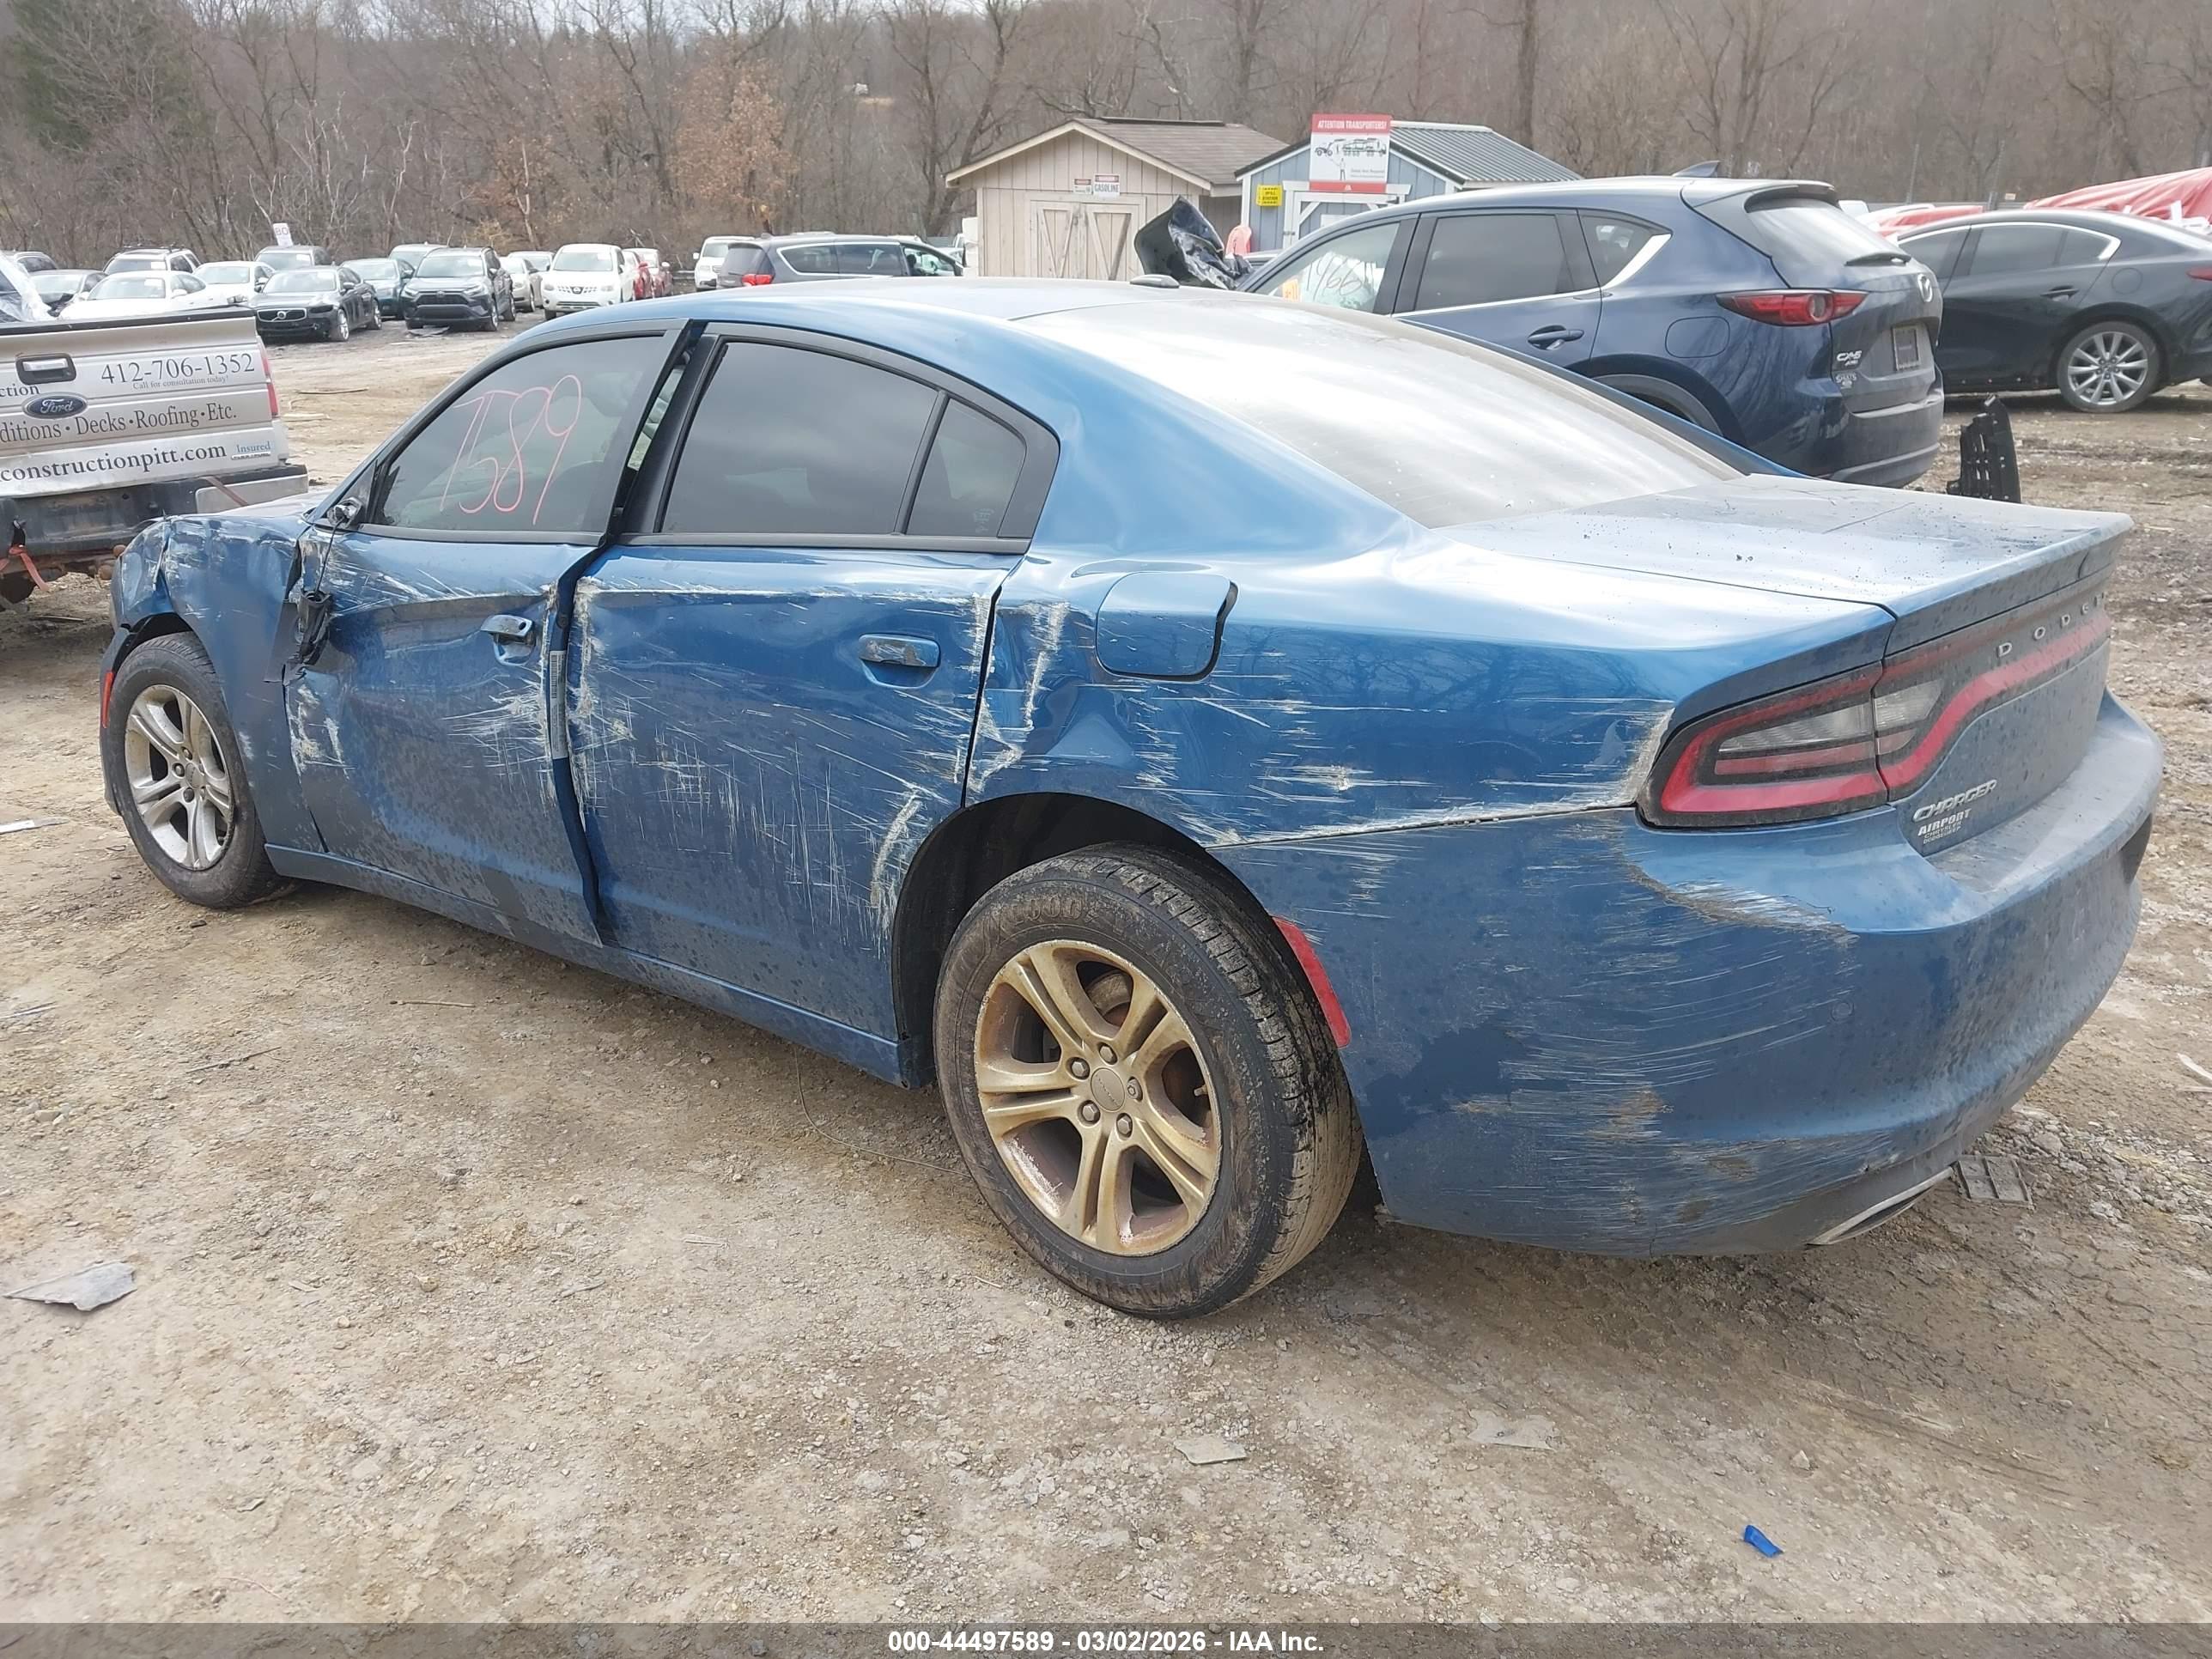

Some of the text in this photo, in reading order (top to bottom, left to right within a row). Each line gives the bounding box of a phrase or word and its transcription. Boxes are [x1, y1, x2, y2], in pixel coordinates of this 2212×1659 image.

[101, 353, 255, 385] 412-706-1352
[133, 381, 150, 390] Call
[162, 378, 206, 387] consultation
[40, 398, 74, 414] Ford
[75, 412, 126, 435] Decks
[134, 405, 200, 428] Roofing
[206, 402, 237, 421] Etc.
[235, 441, 271, 453] Insured
[1912, 779, 1997, 823] CHARGER
[1917, 808, 1972, 836] AIRPORT
[1923, 821, 1962, 839] CHRYSLER
